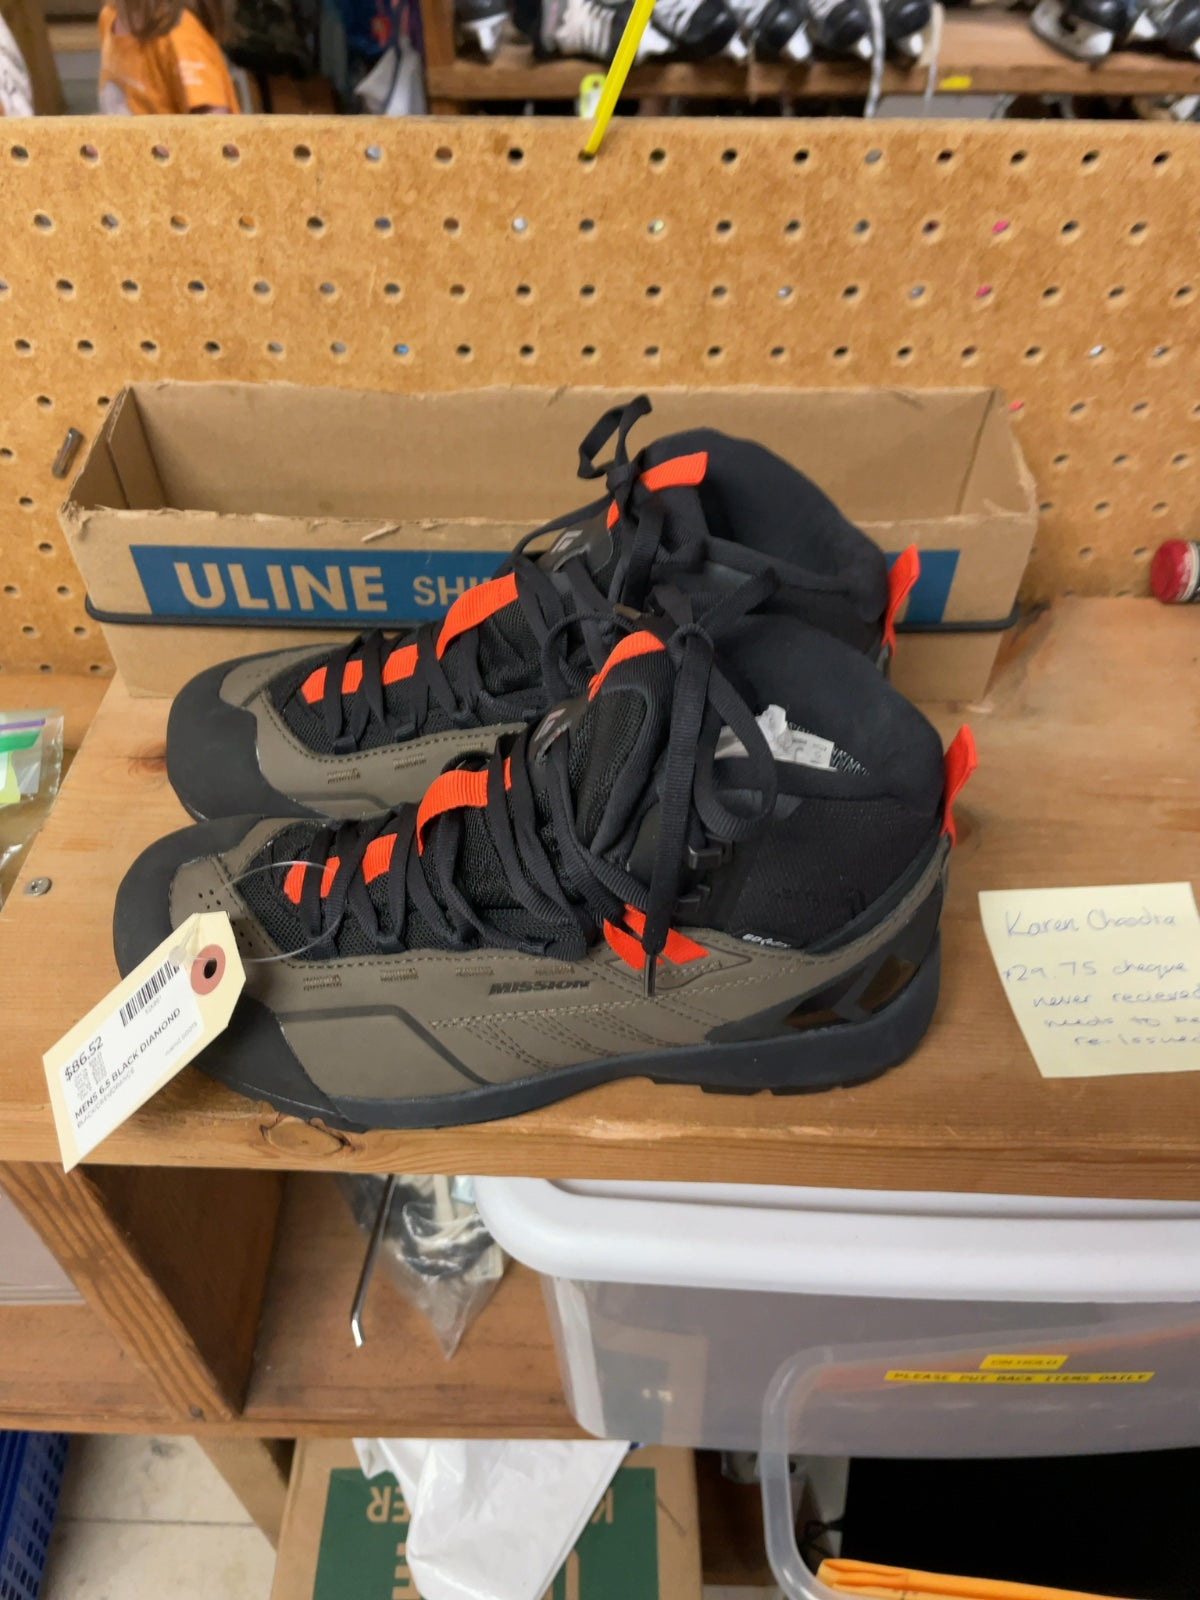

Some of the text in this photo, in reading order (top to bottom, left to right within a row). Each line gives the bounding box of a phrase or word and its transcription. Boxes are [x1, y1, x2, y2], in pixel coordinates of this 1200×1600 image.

[174, 562, 387, 611] ULINE
[488, 980, 591, 995] MISSION
[65, 1036, 103, 1081] $86.52
[75, 1091, 98, 1119] MENS
[99, 1079, 111, 1095] 6.5
[112, 1050, 139, 1081] BLACK
[140, 1008, 181, 1053] DIAMOND
[894, 1373, 949, 1381] PLEASE
